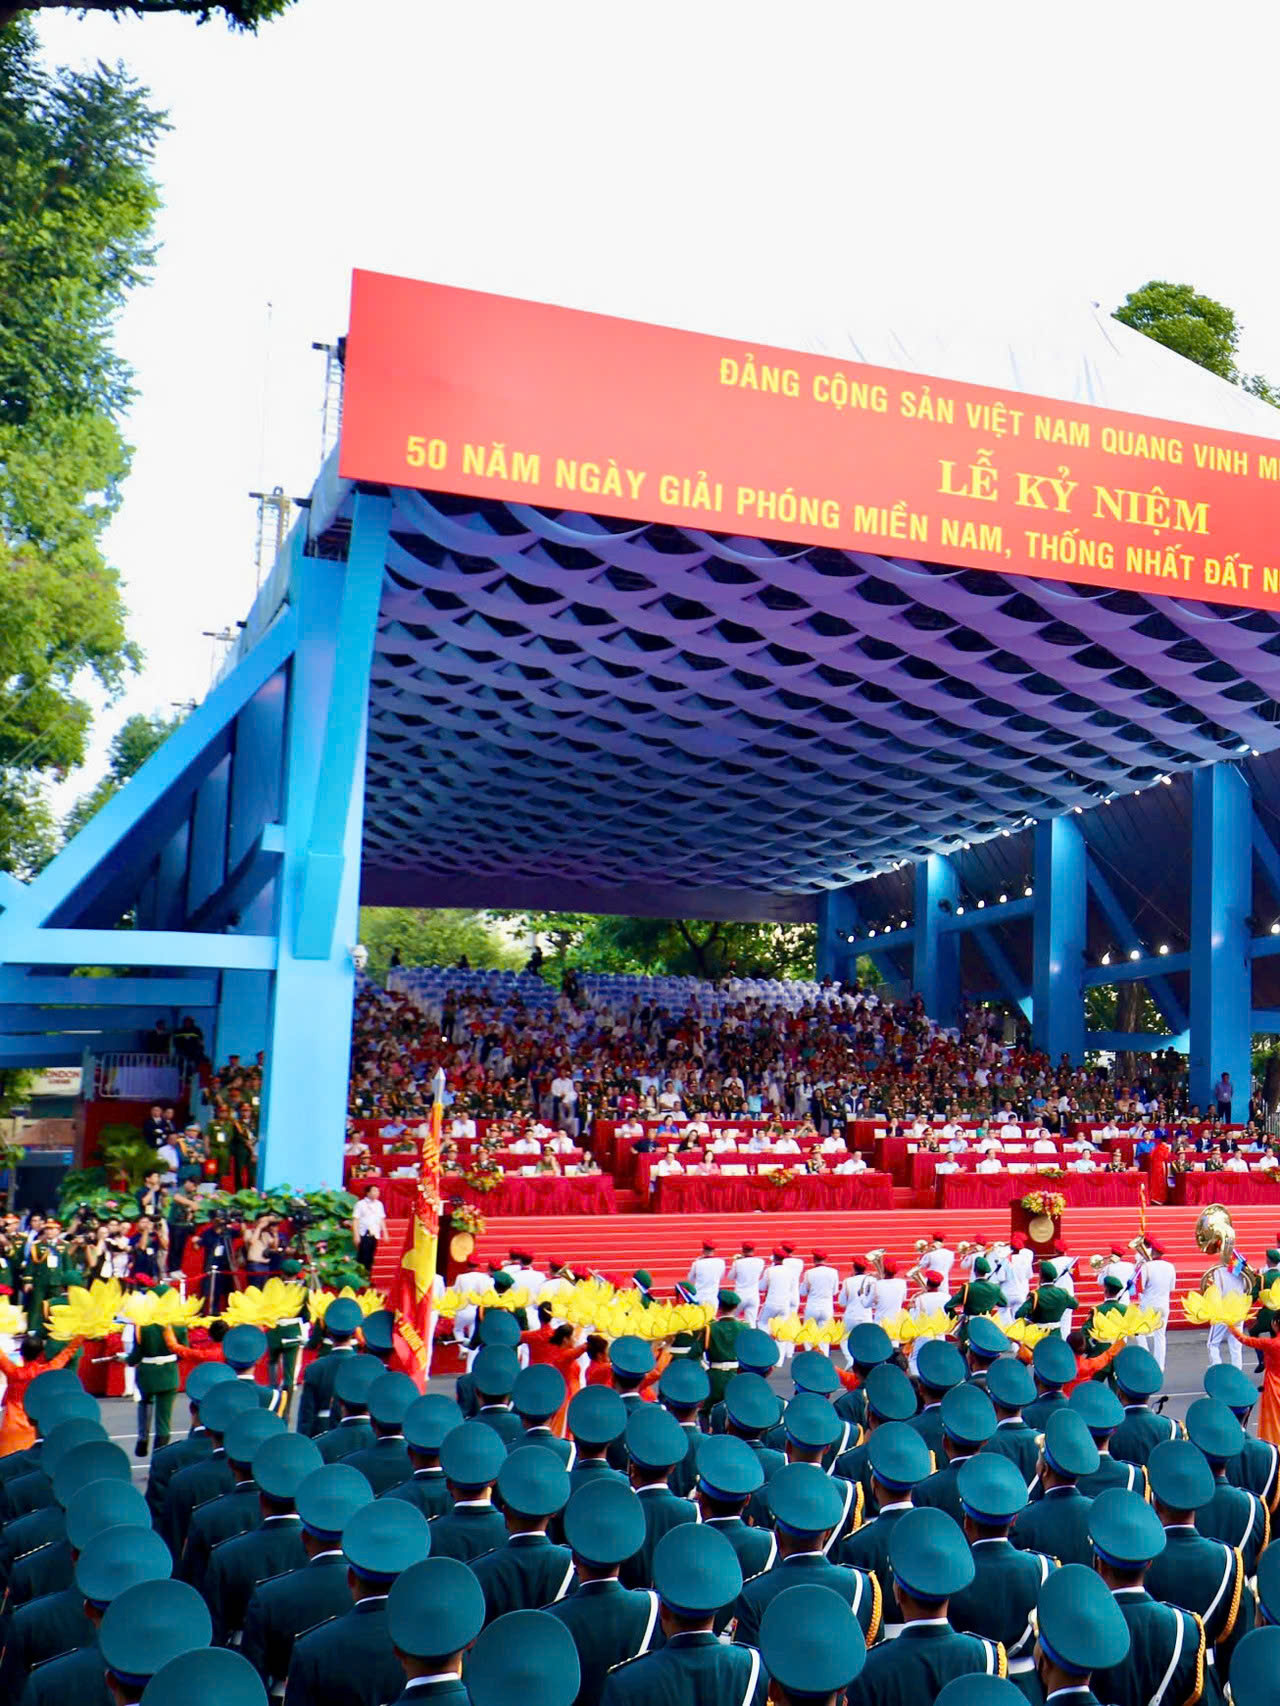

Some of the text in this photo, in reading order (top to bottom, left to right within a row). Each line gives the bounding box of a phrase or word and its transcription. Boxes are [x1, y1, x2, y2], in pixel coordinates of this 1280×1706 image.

[719, 353, 801, 399] ĐẢNG
[813, 372, 889, 413] CỘNG
[899, 386, 956, 425] SẢN
[965, 401, 1024, 438] VIỆT
[1034, 415, 1092, 449] NAM
[1100, 427, 1184, 466] QUANG
[1192, 443, 1250, 476] VINH
[406, 435, 448, 470] 50
[462, 441, 541, 485] NĂM
[555, 457, 647, 500] NGÀY
[659, 470, 724, 512] GIẢI
[736, 488, 841, 530] PHÓNG
[853, 500, 930, 543] MIỀN
[940, 517, 1014, 559] NAM,
[1024, 528, 1115, 571] THỐNG
[1124, 544, 1196, 583] NHẤT
[1203, 553, 1255, 590] ĐẤT
[937, 448, 1211, 537] LỄ KỶ NIỆM
